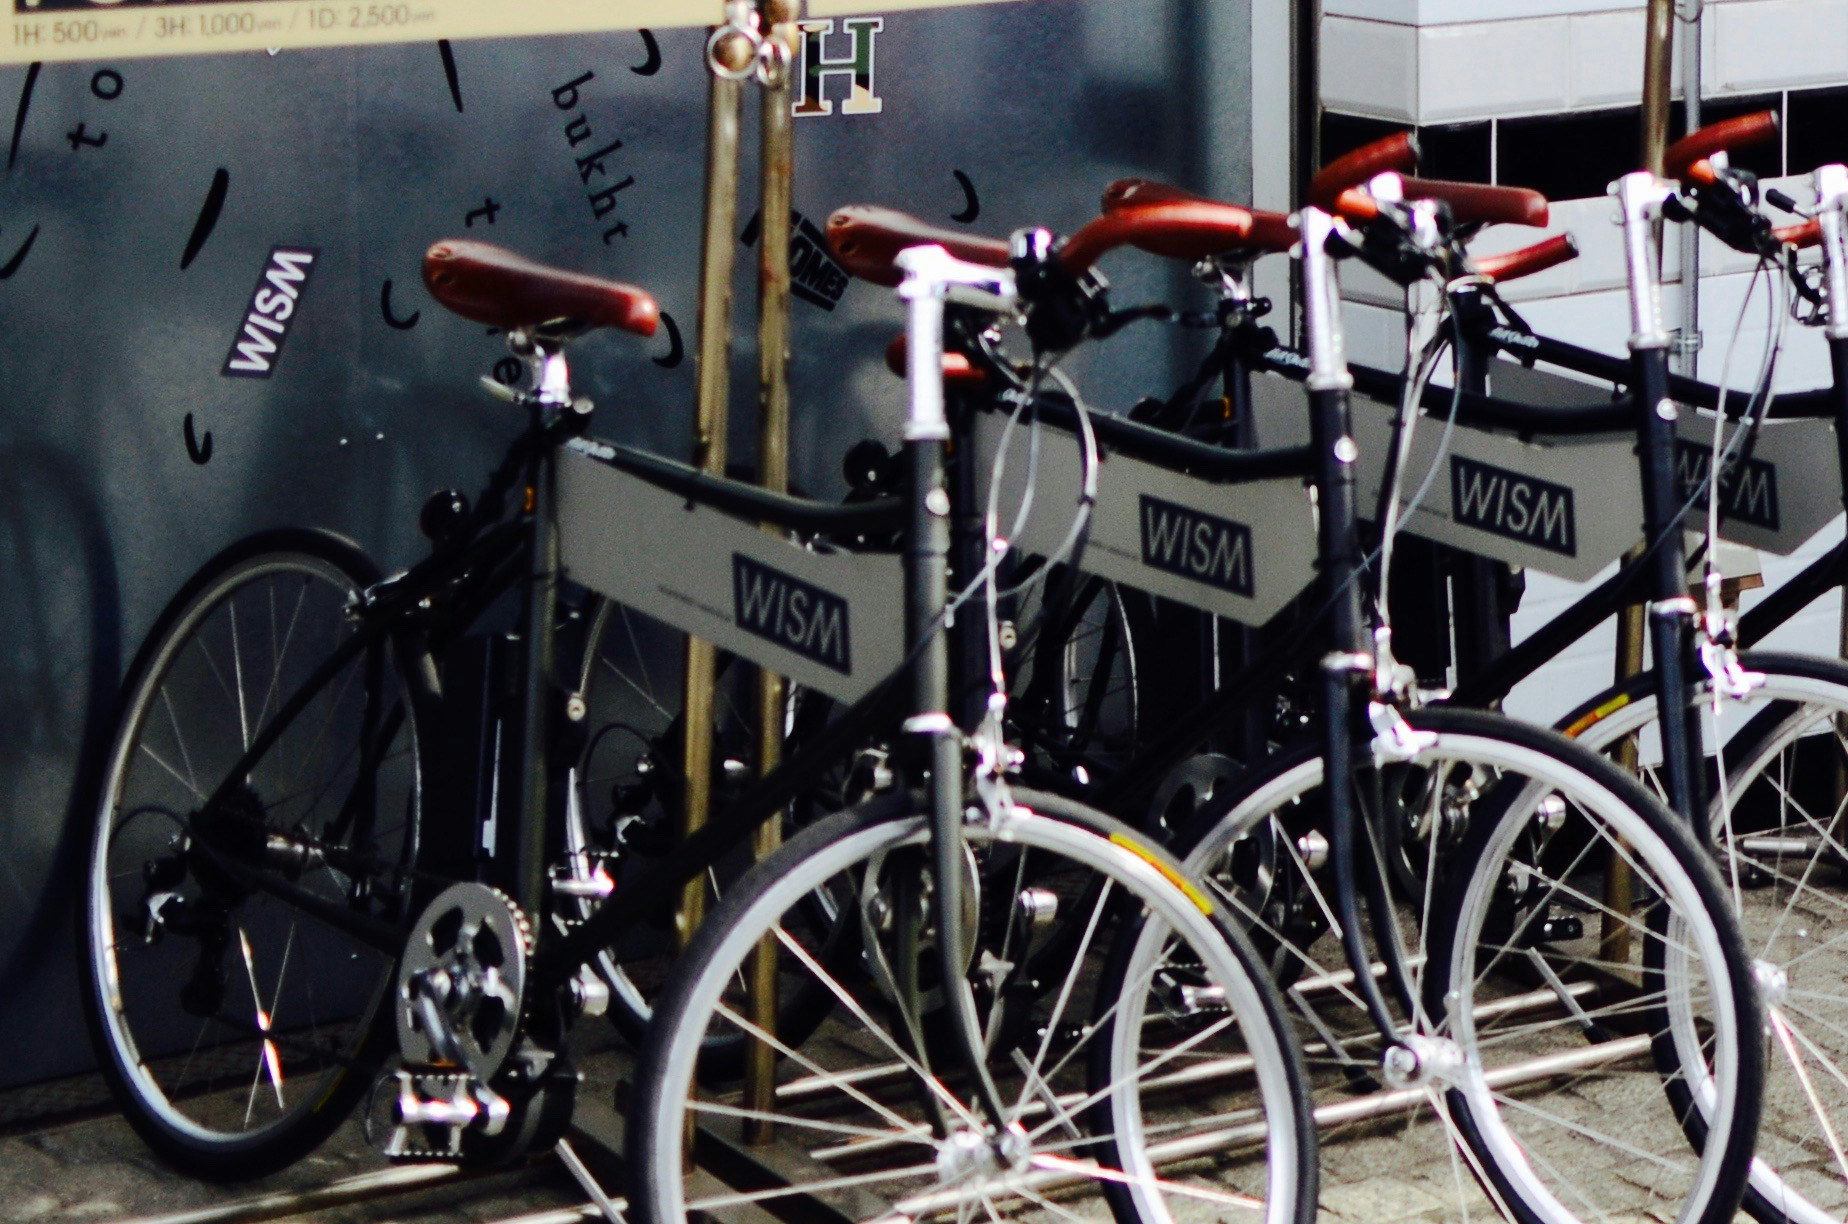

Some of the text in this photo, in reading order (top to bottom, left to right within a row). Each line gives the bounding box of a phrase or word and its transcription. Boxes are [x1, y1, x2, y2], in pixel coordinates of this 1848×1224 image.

[551, 70, 636, 246] bukht
[228, 251, 314, 373] WISM
[1145, 505, 1247, 588] WISM
[1457, 464, 1568, 549] WISM
[737, 564, 845, 664] WISM
